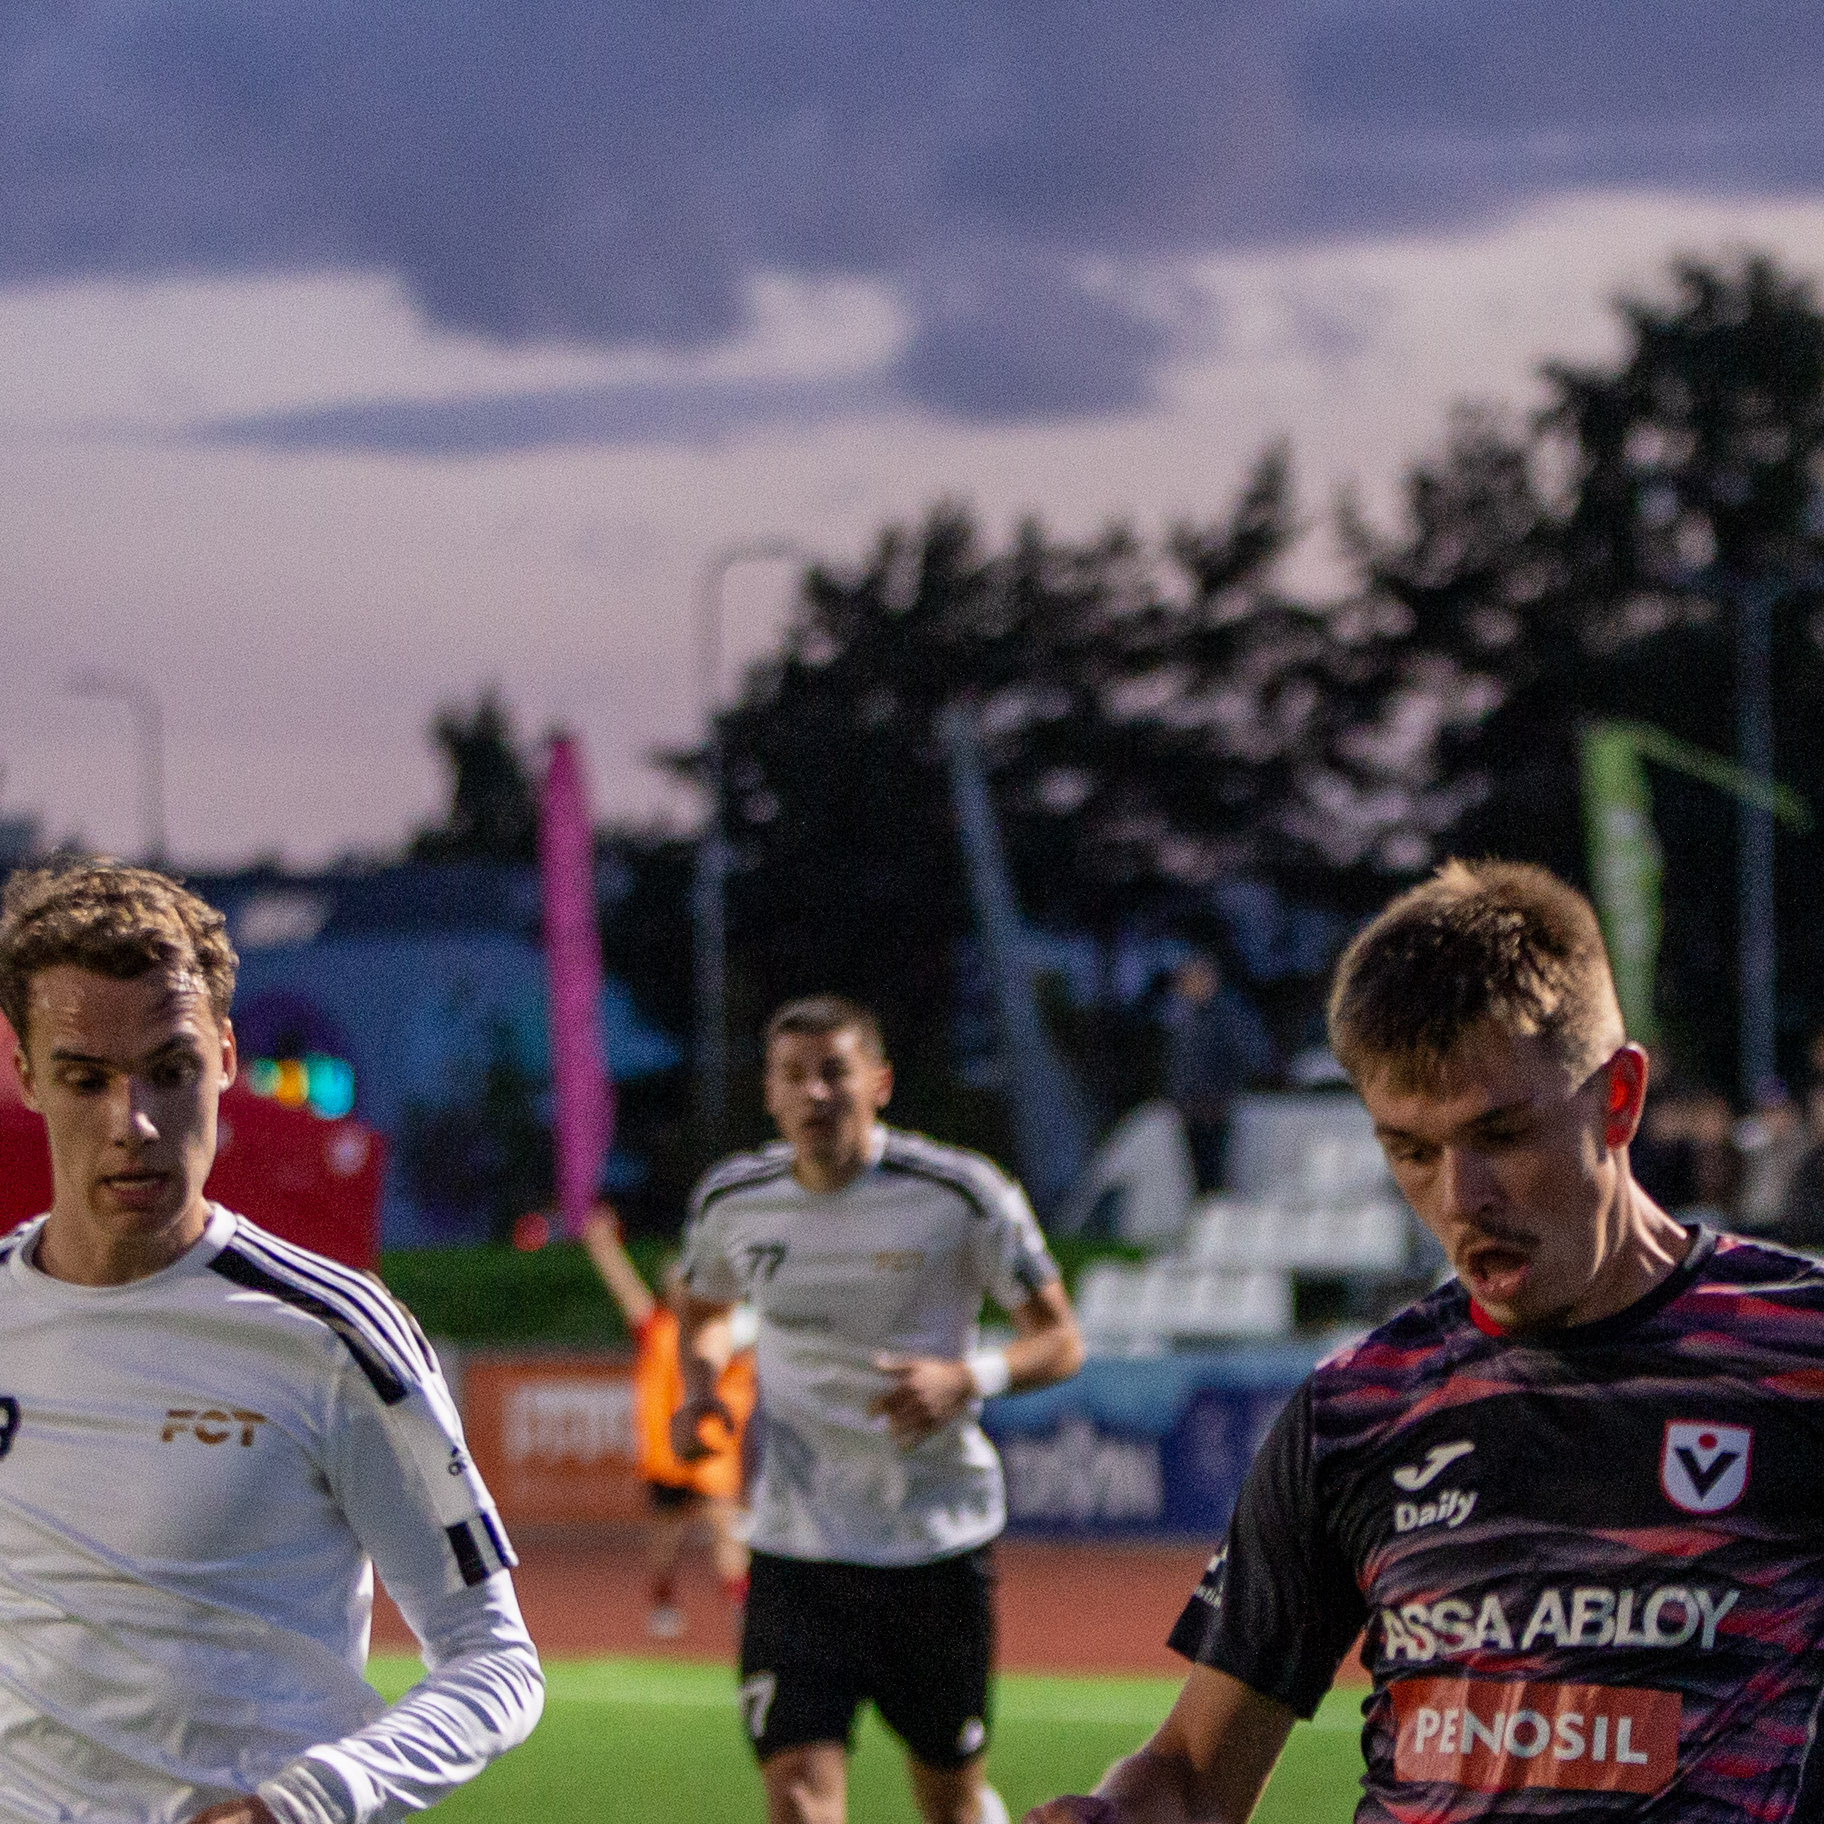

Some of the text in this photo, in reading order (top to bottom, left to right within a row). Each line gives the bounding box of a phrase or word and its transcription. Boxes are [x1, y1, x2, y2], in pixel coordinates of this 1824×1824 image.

[160, 1408, 268, 1448] FCT
[1395, 1488, 1479, 1532] Daily
[1382, 1586, 1740, 1661] ASSA ABLOY
[1414, 1708, 1648, 1765] PENOSIL
